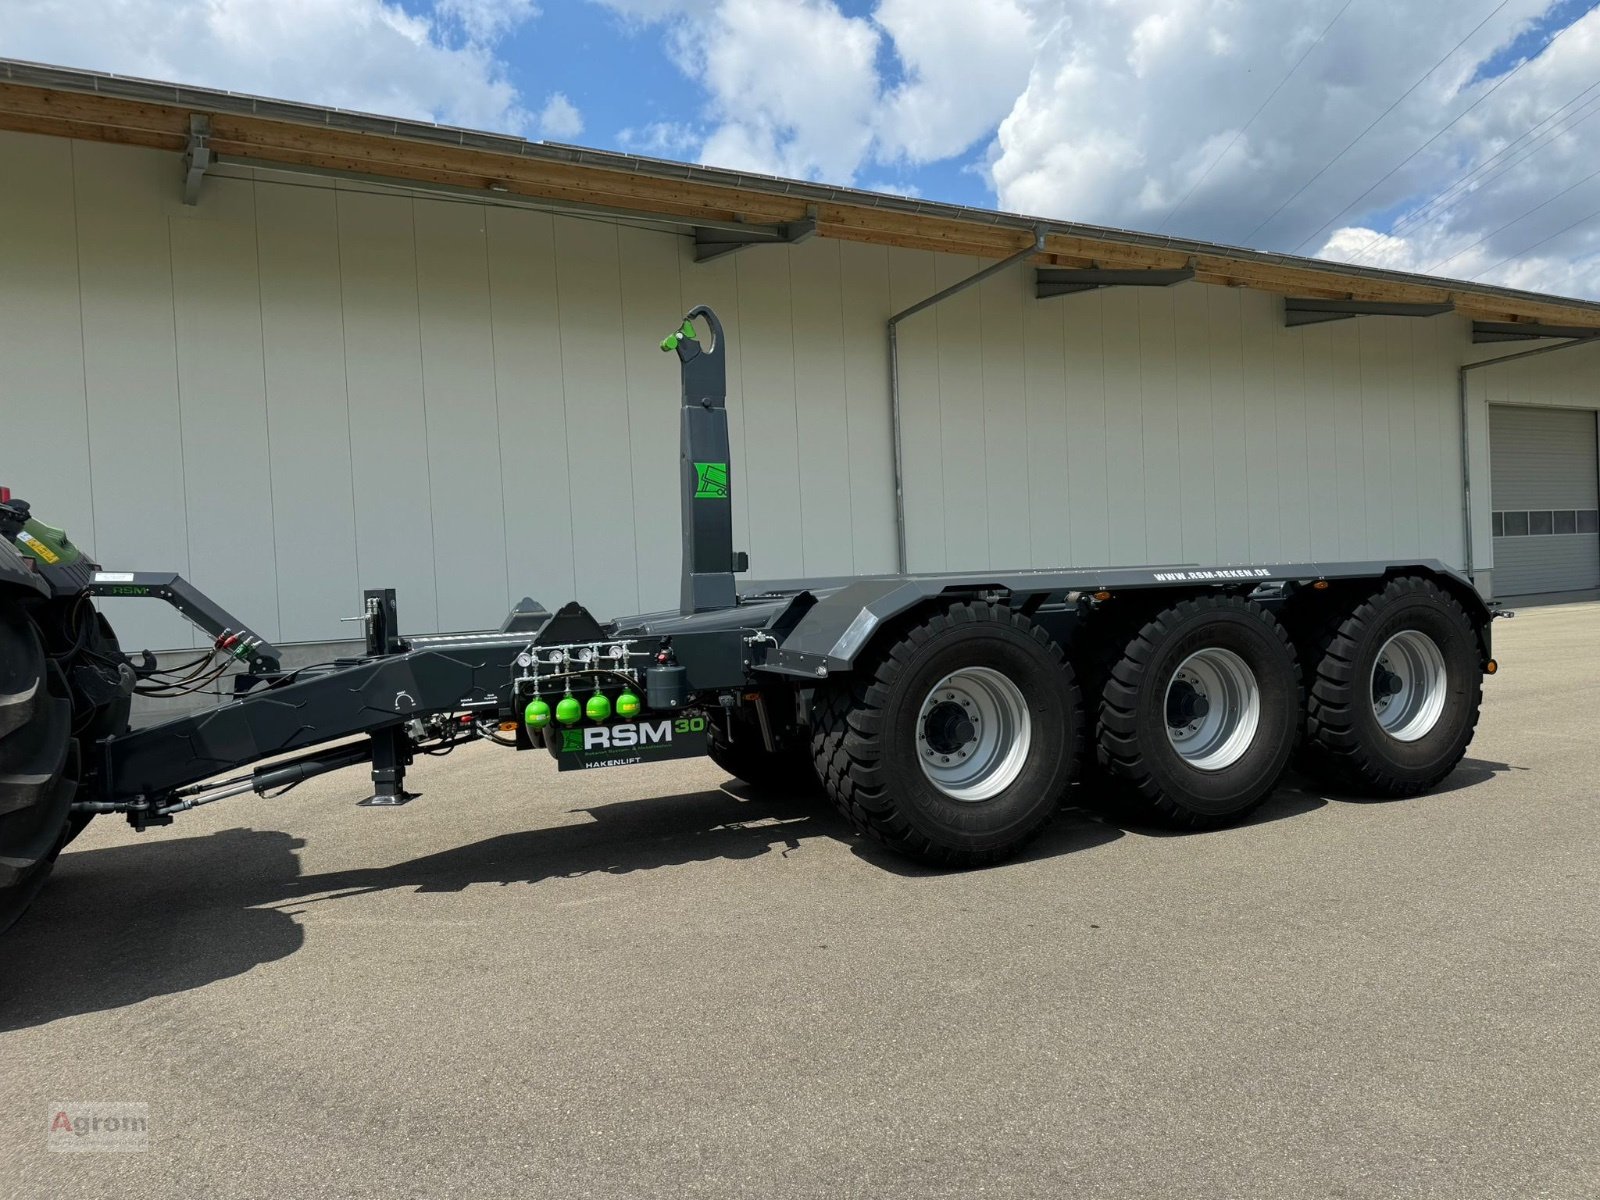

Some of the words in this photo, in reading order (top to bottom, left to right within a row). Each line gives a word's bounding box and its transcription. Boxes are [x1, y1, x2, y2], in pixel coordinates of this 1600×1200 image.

[1153, 568, 1271, 581] WWW.RSM-REKEN.DE
[112, 586, 147, 594] RSM
[584, 720, 672, 750] RSM
[674, 717, 704, 733] 30
[585, 757, 641, 768] HAKENLIFT
